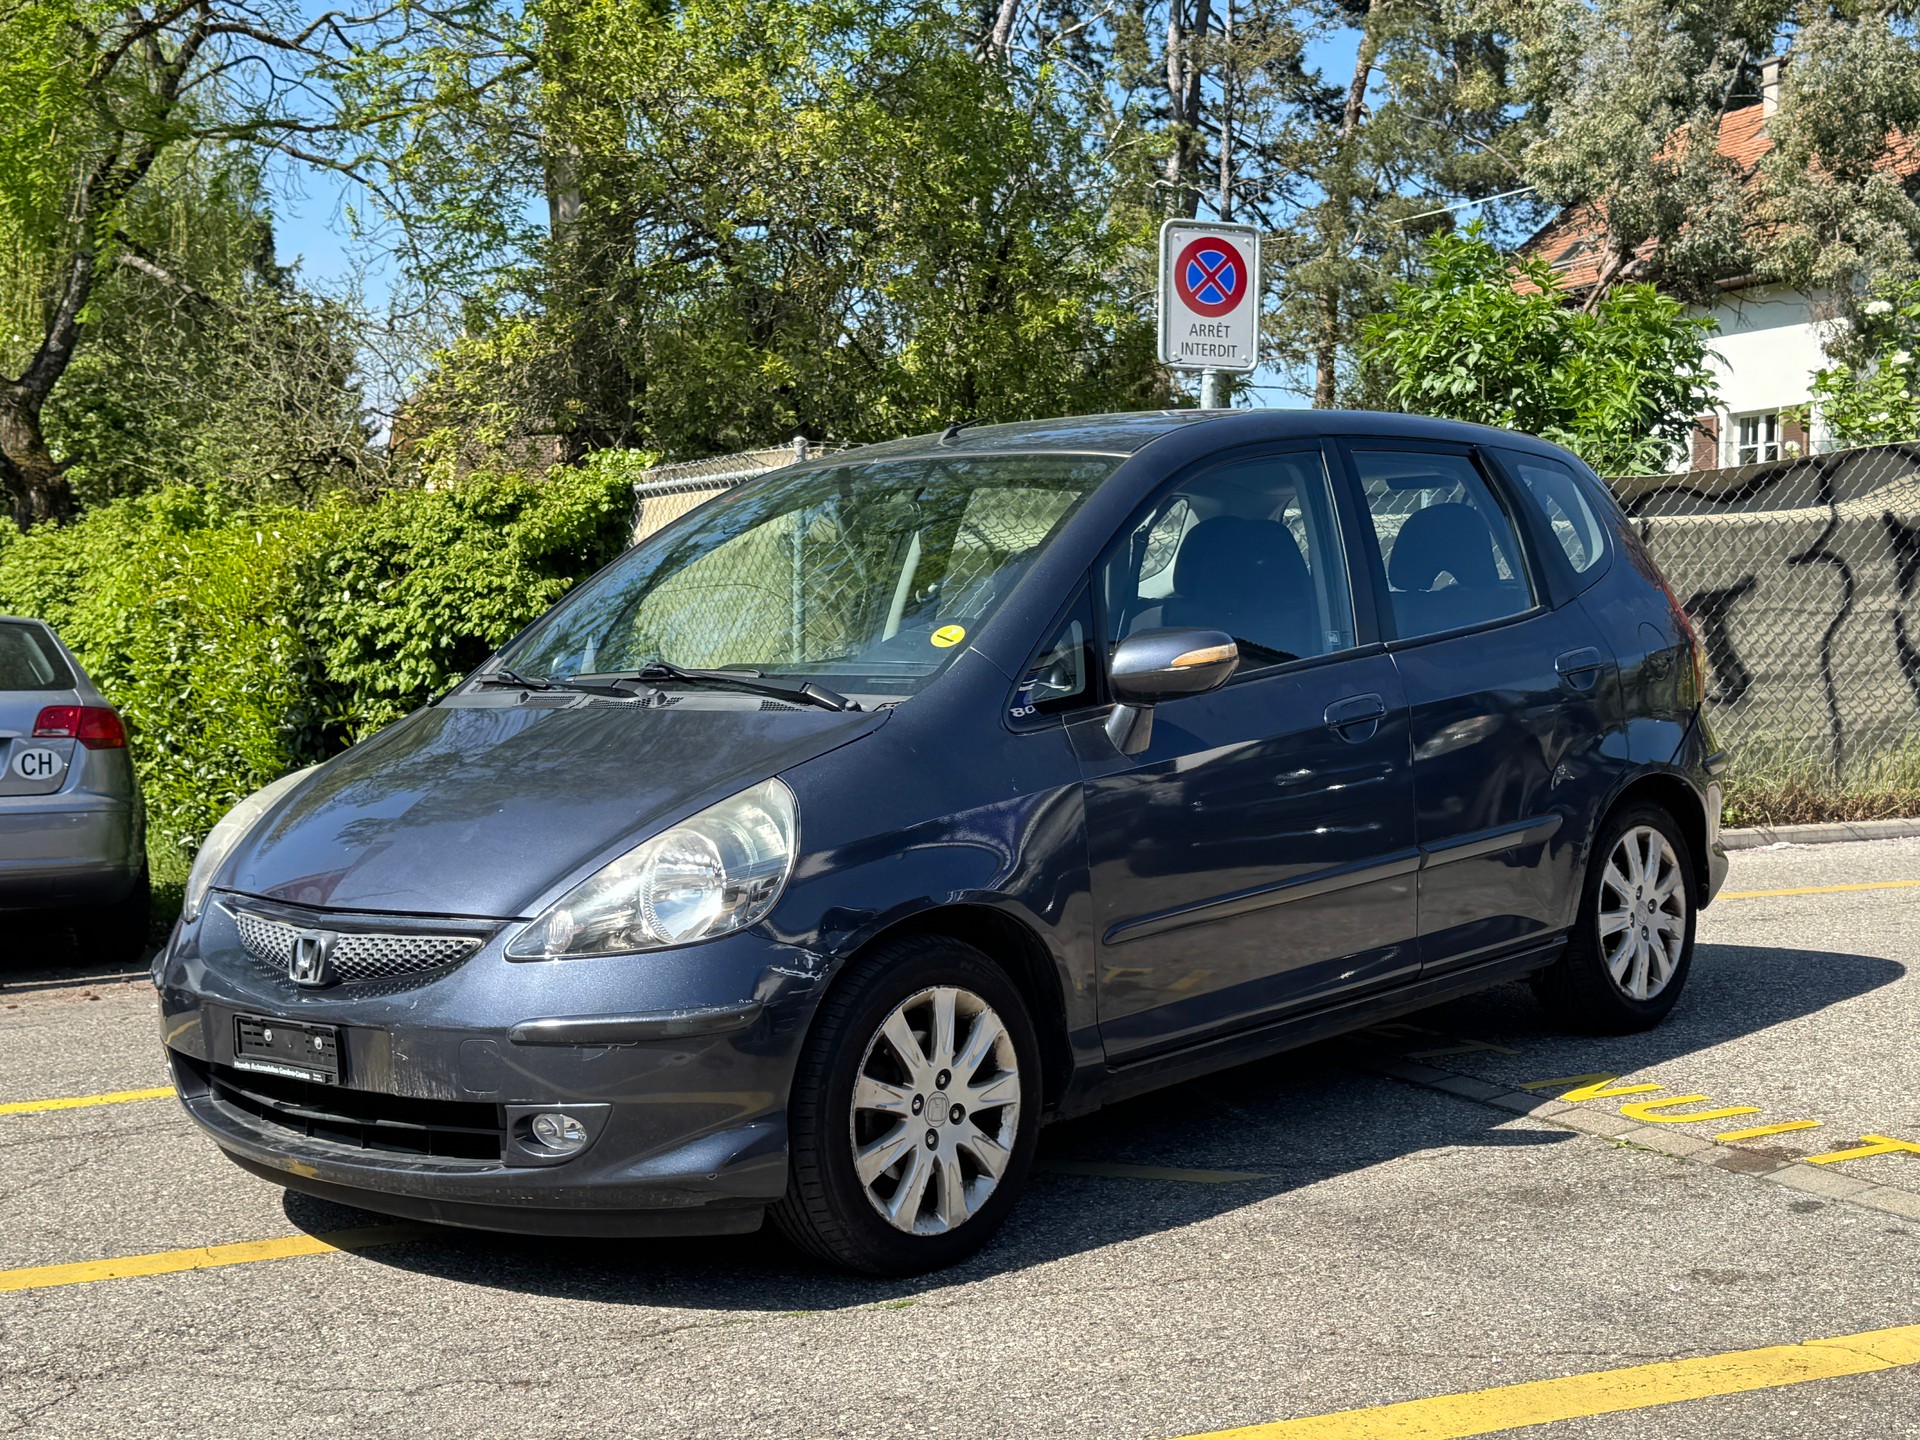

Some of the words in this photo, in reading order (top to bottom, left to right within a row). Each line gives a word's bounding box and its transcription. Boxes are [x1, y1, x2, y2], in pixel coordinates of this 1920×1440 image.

[1189, 322, 1230, 338] ARRÊT
[1181, 342, 1238, 358] INTERDIT
[21, 753, 52, 776] CH
[1520, 1072, 1920, 1165] NUIT
